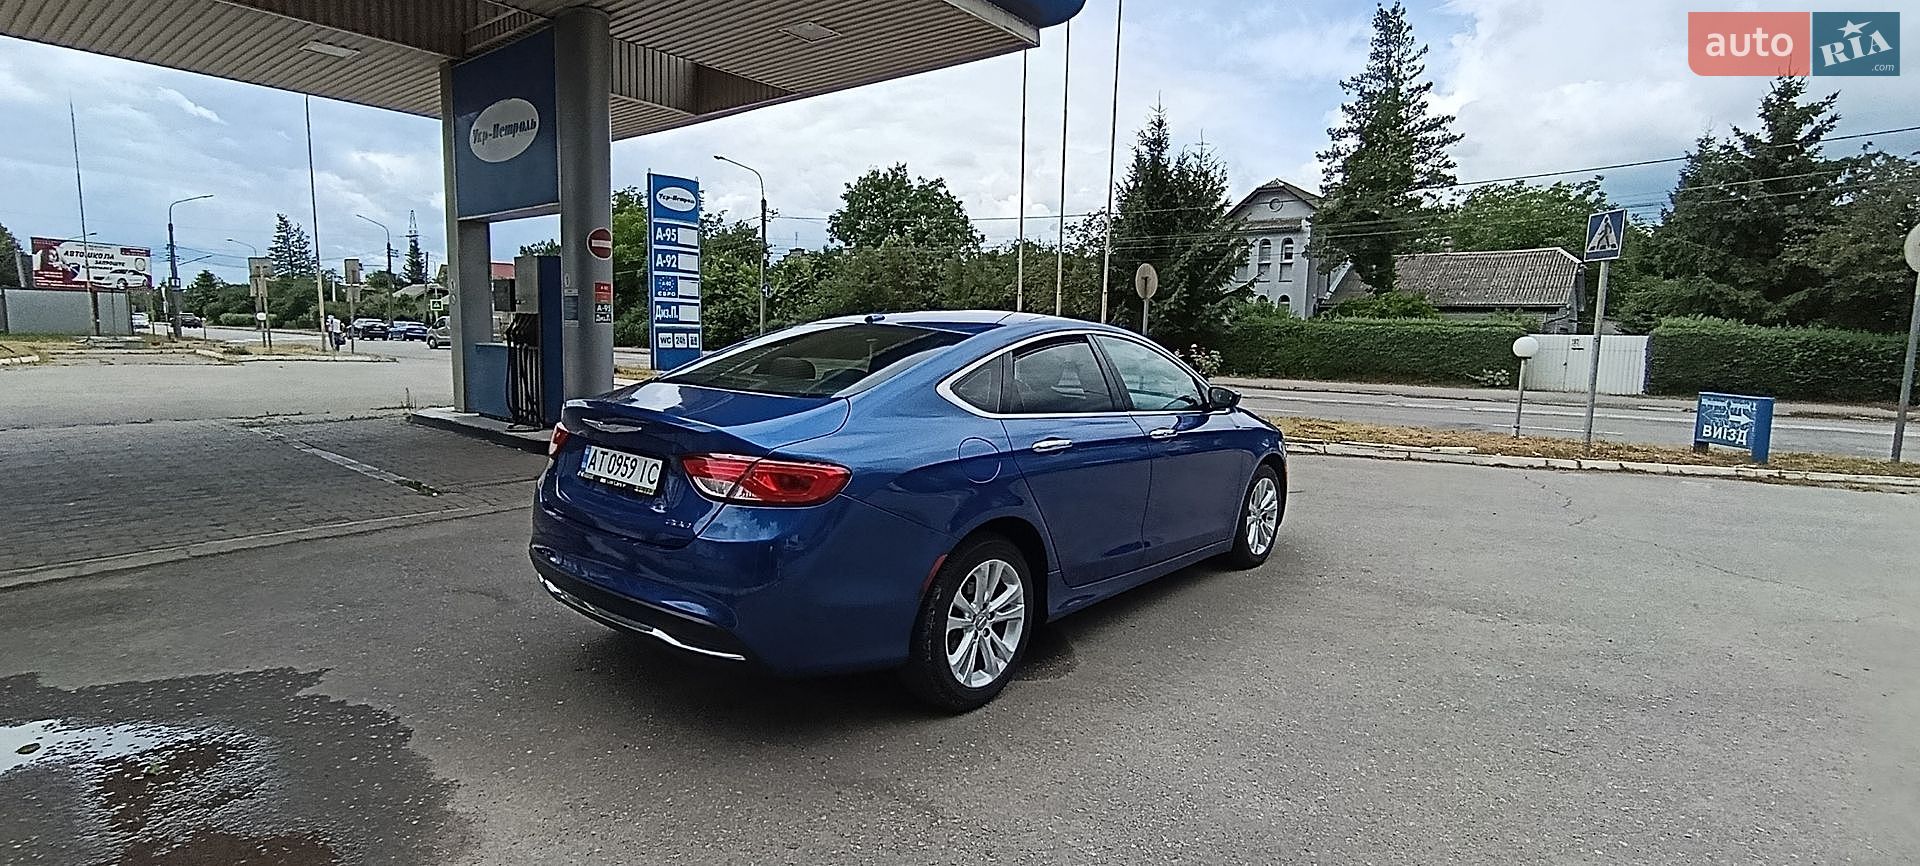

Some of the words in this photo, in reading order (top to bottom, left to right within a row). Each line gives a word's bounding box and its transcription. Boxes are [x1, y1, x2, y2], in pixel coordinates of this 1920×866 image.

[472, 118, 537, 146] Укр-Петроль
[588, 450, 608, 471] AT
[607, 454, 637, 478] 0959
[640, 461, 659, 484] IC
